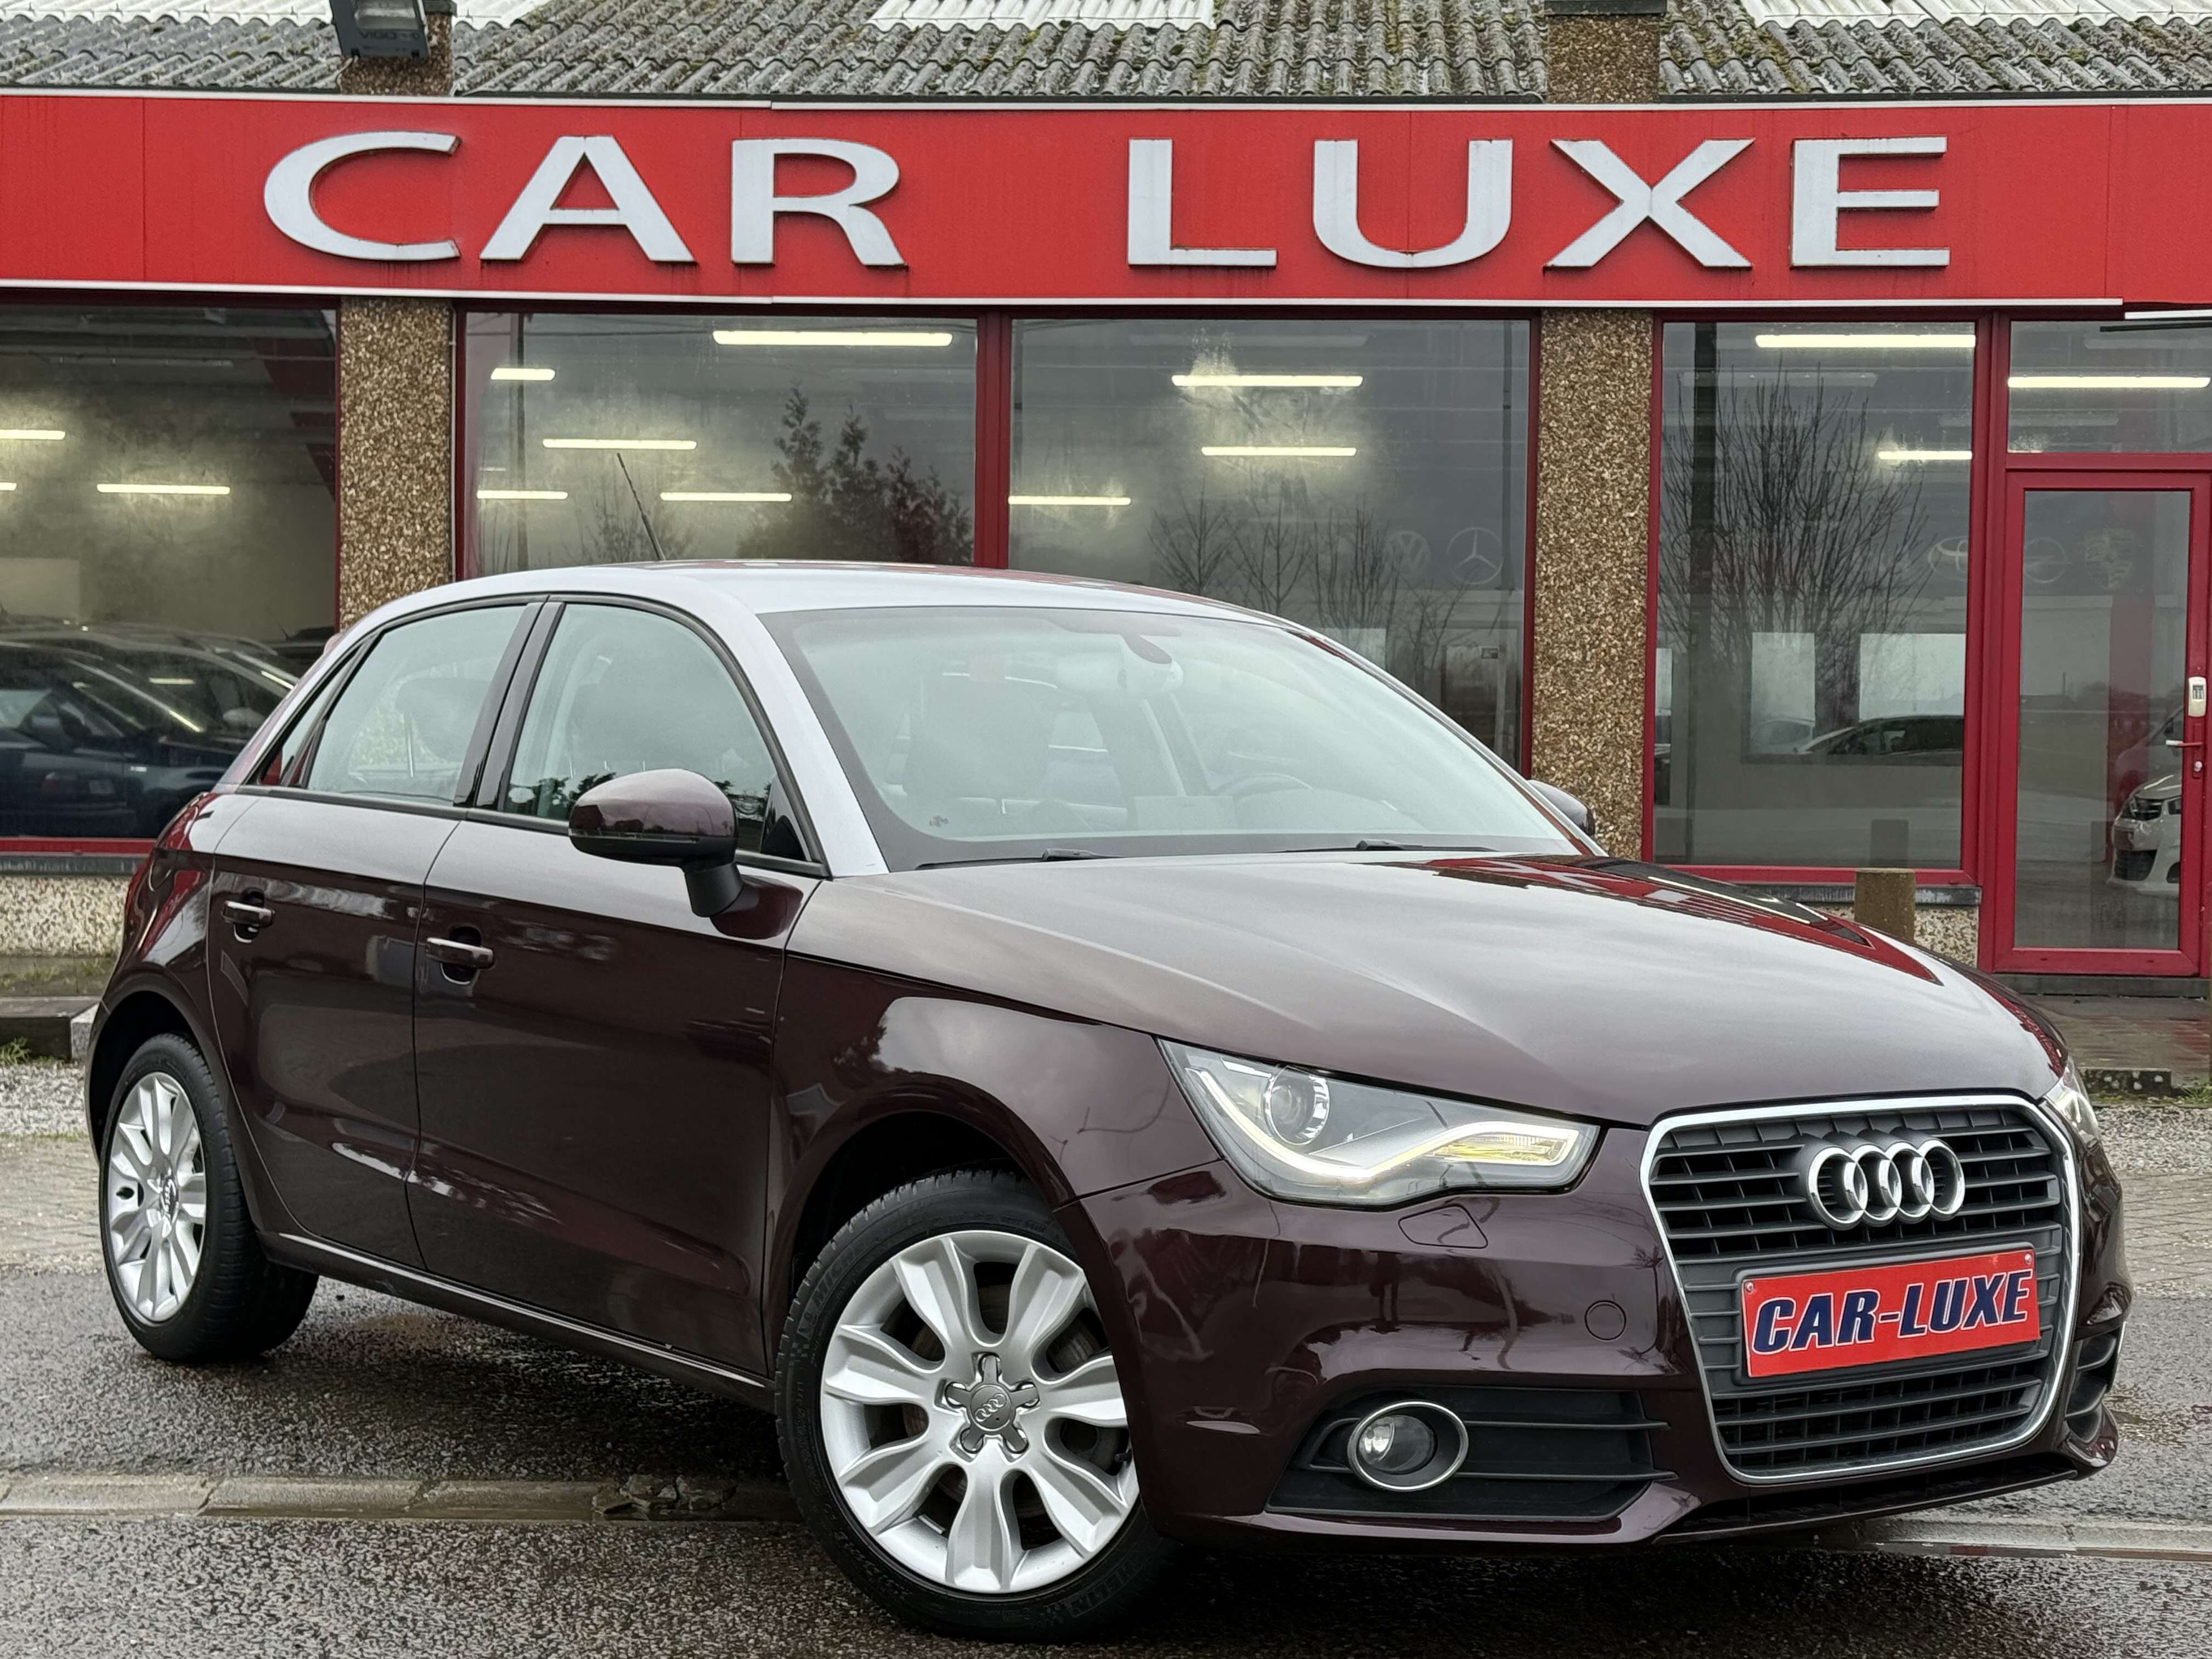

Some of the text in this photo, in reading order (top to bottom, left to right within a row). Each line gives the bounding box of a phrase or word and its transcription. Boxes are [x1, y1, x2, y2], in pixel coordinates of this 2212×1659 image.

[263, 131, 1951, 269] CAR LUXE
[1751, 1268, 2034, 1356] CAR-LUXE
